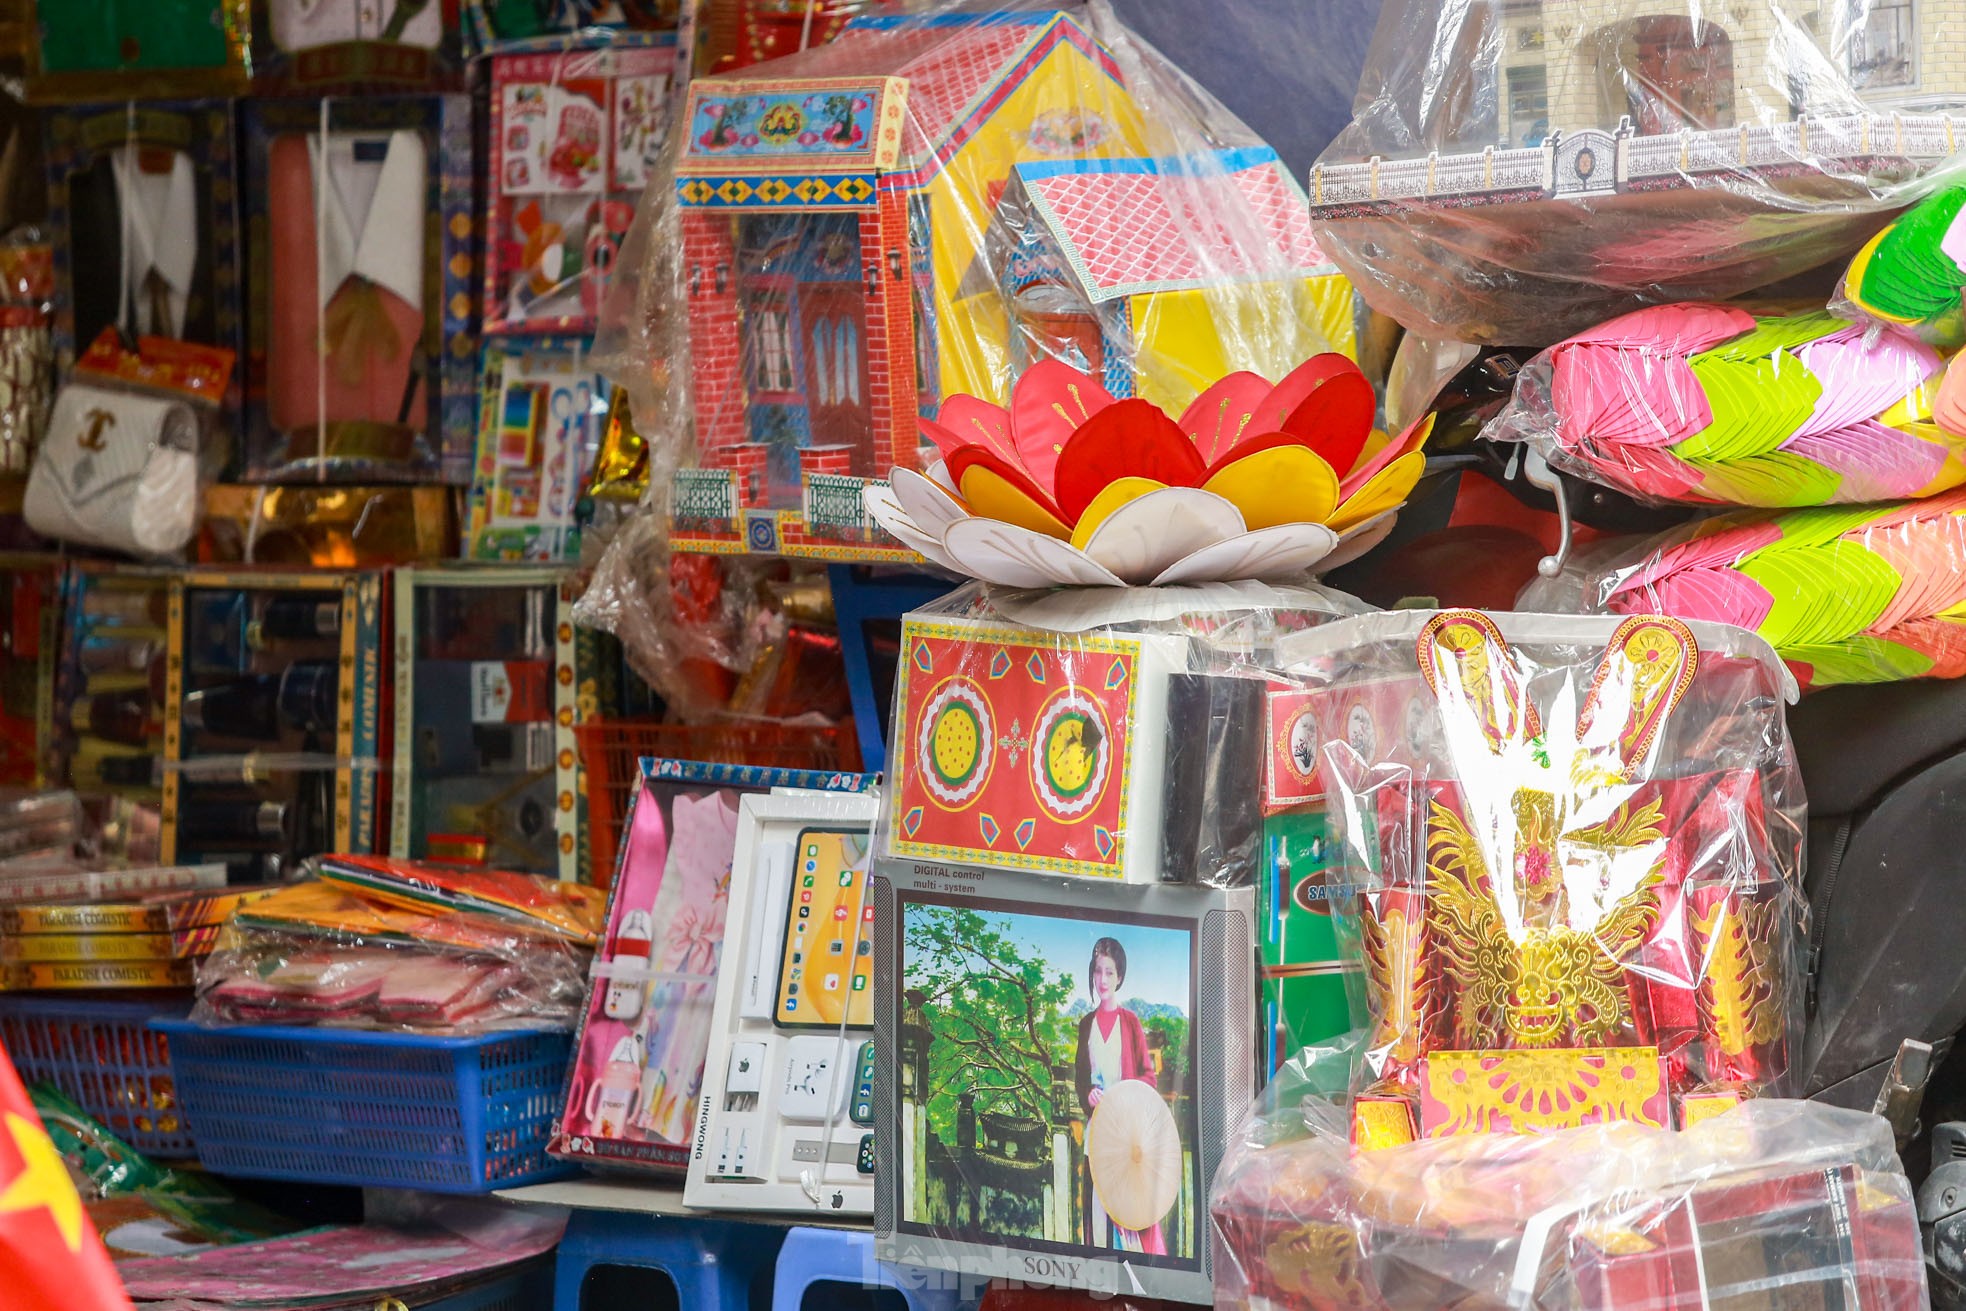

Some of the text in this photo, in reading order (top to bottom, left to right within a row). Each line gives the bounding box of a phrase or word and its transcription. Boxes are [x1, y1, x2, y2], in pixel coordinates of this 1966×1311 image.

[914, 864, 985, 881] DIGITAL control
[914, 880, 936, 890] multi
[944, 883, 975, 894] system
[53, 967, 99, 981] PARADISE
[695, 1096, 711, 1160] HINGWONG
[1024, 1256, 1081, 1281] SONY
